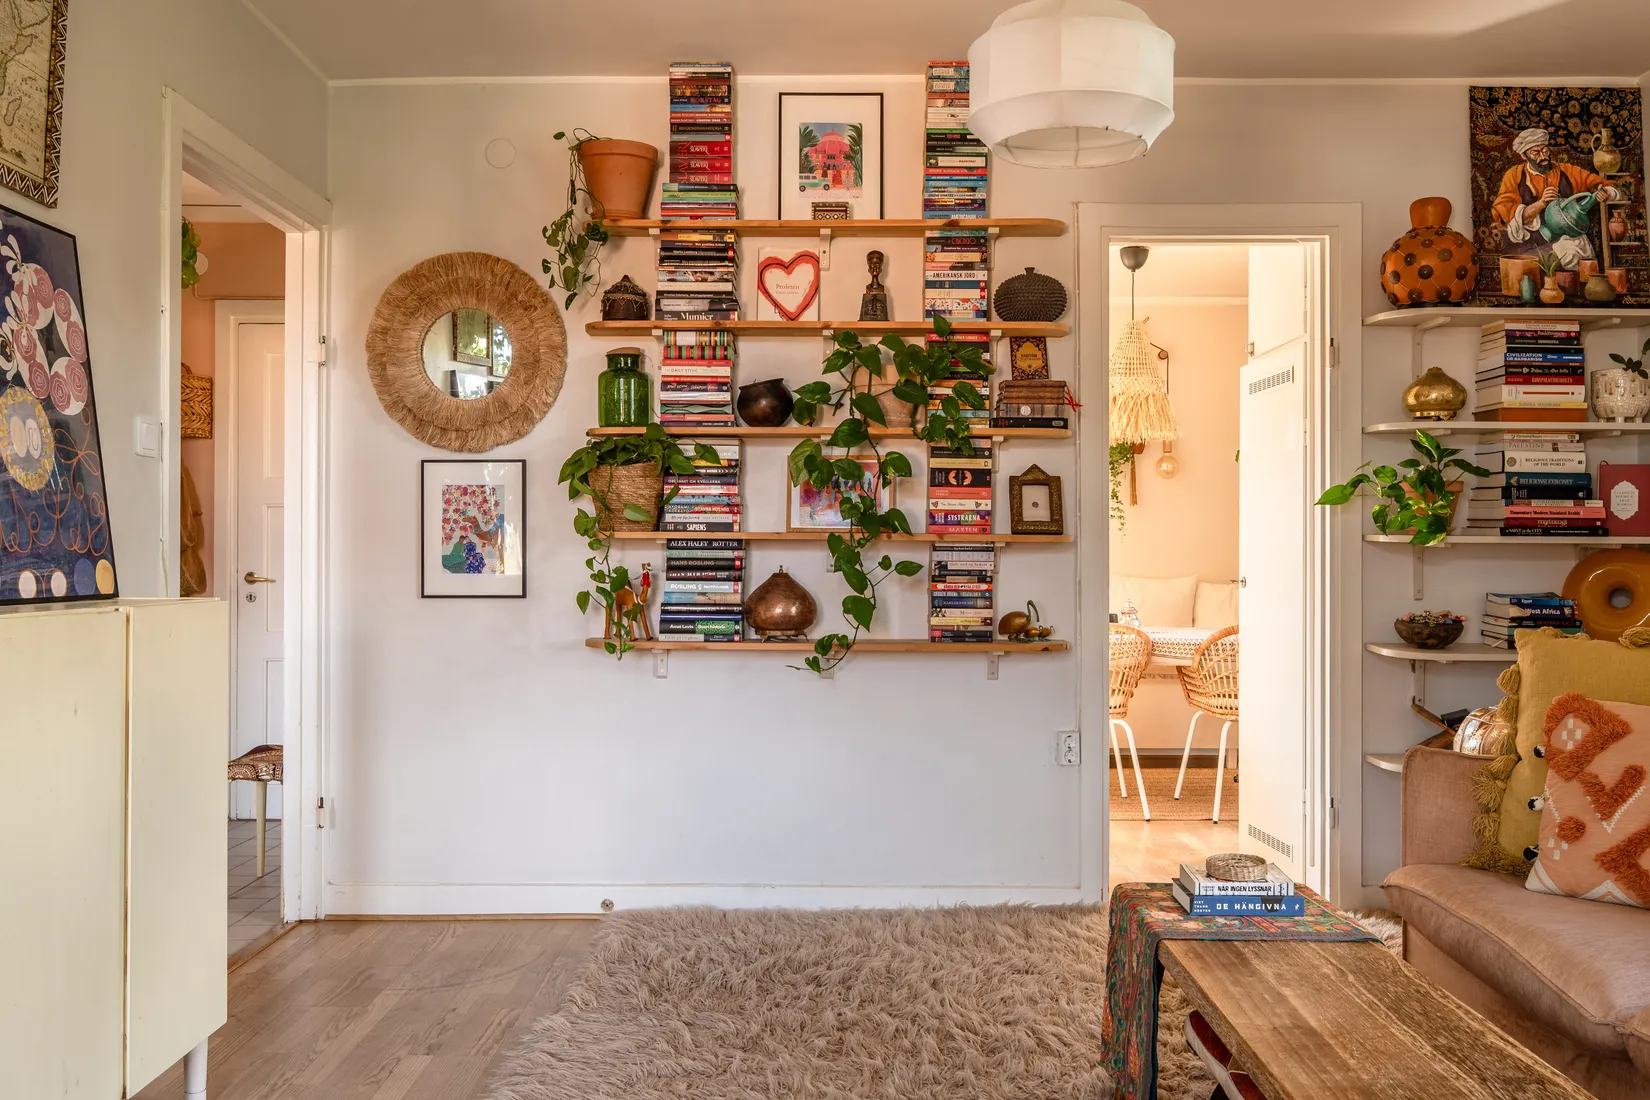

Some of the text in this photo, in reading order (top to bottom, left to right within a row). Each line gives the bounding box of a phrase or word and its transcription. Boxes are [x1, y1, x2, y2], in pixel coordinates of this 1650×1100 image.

[680, 312, 714, 321] Mumier
[686, 523, 707, 531] SAPIENS
[1537, 519, 1568, 527] mytologi
[1234, 901, 1287, 910] HÄNGIVNA
